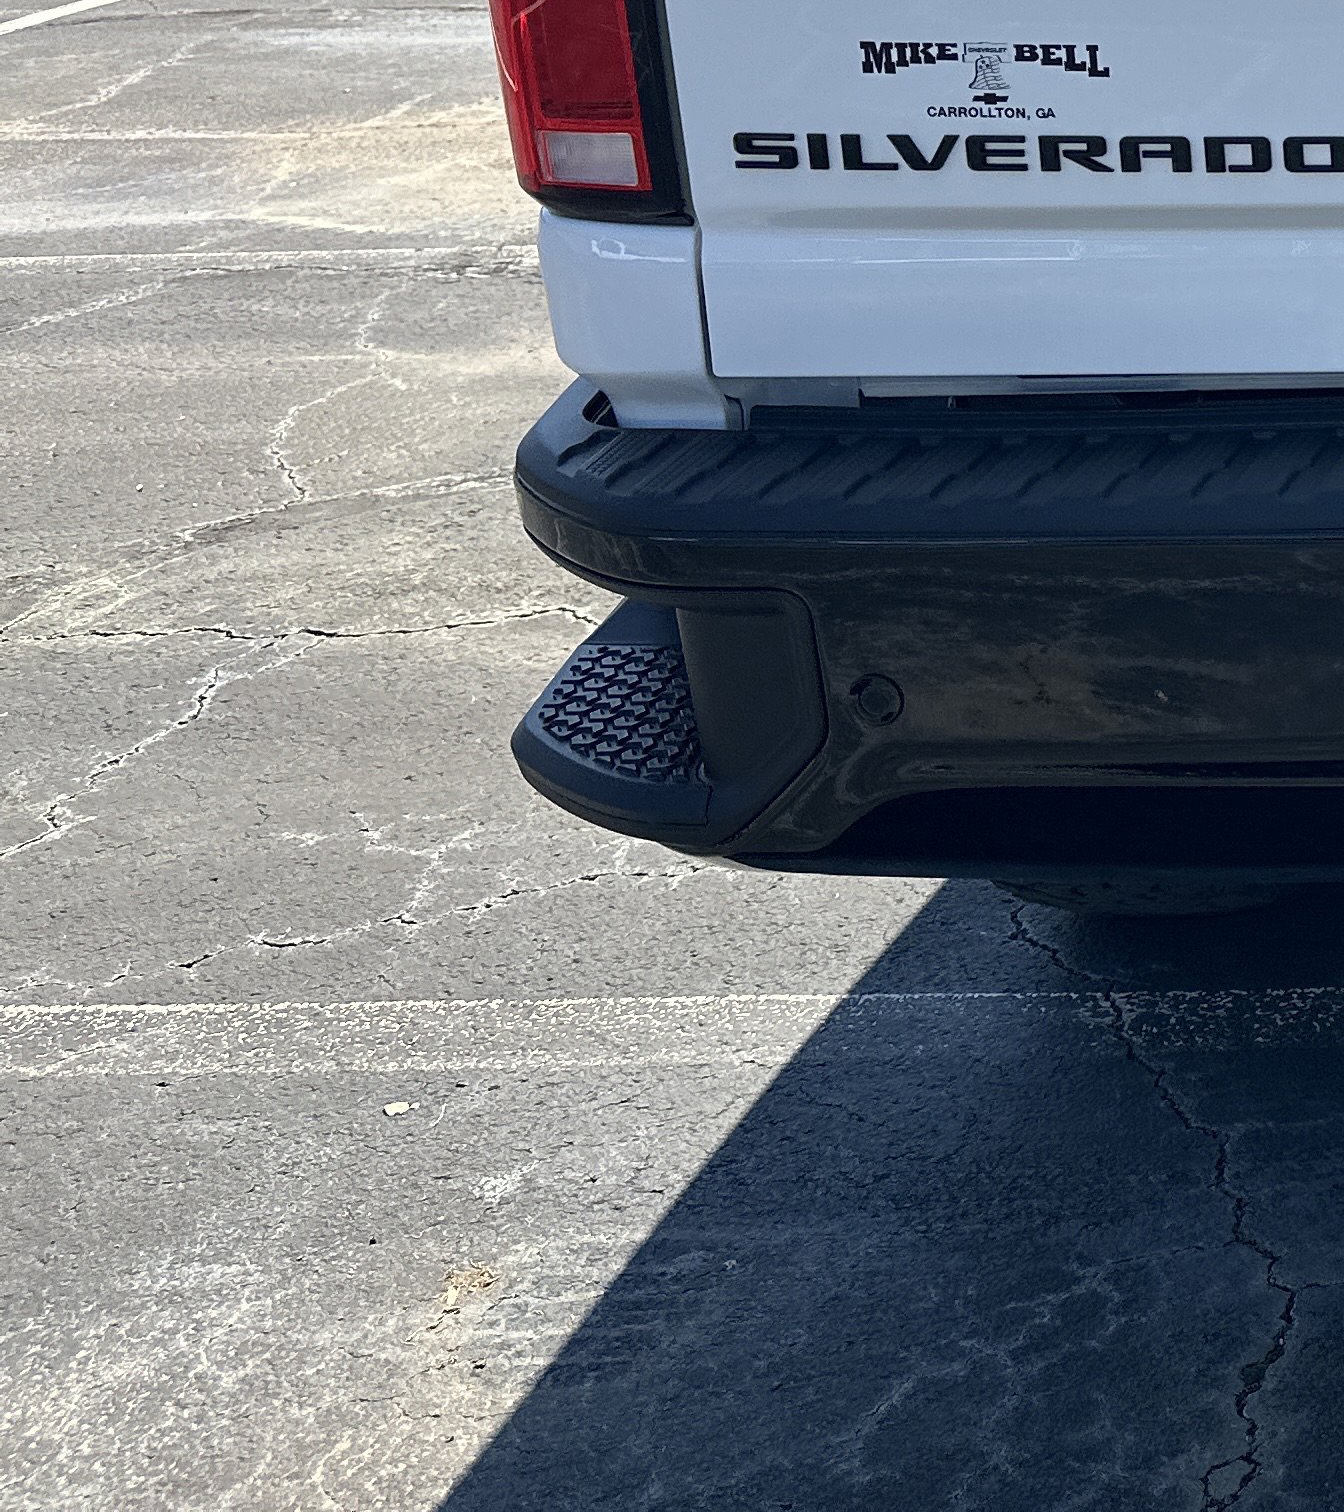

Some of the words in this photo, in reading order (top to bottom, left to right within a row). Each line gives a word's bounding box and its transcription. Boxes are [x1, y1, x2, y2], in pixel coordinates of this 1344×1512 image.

[859, 41, 959, 74] MIKE
[1013, 44, 1110, 78] BELL
[927, 106, 1031, 120] CARROLLTON,
[1035, 107, 1056, 119] GA
